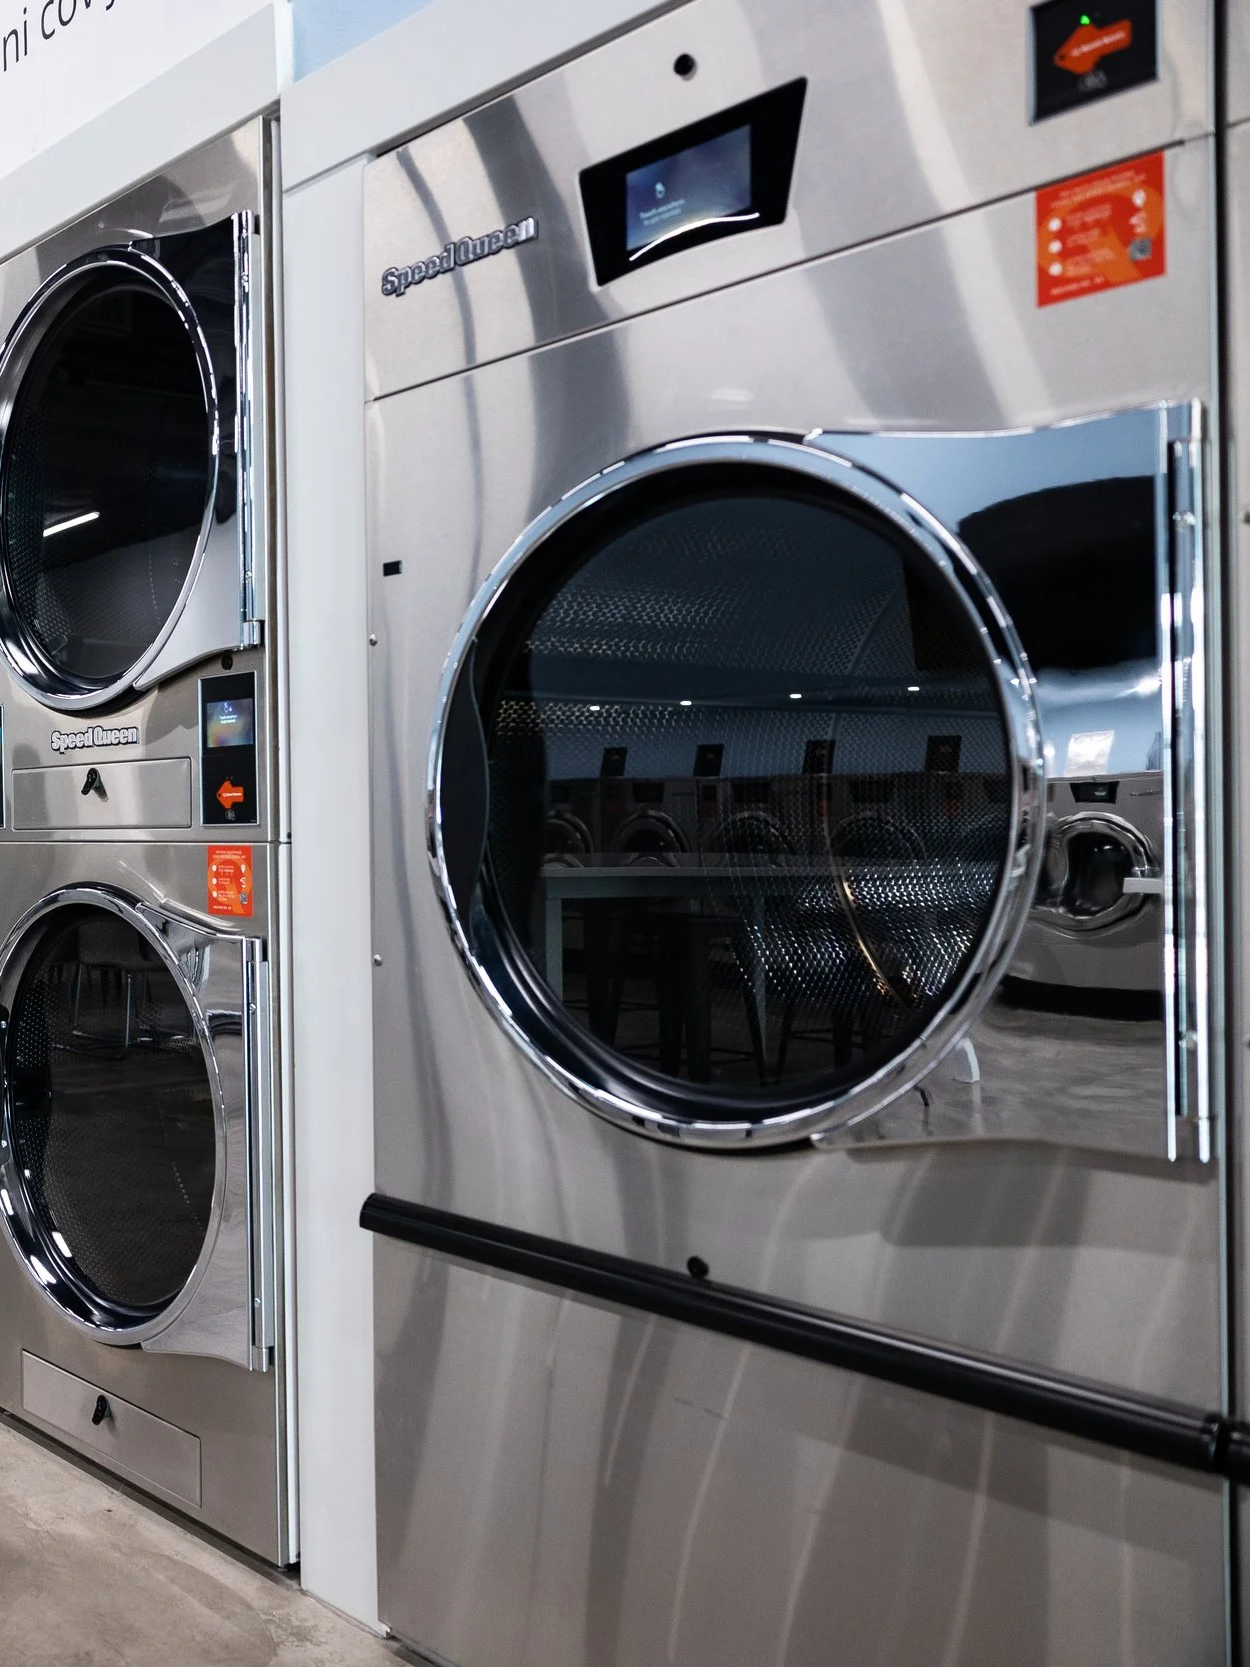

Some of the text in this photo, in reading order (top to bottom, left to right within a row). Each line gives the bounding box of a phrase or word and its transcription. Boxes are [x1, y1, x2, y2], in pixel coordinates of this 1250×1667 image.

[3, 6, 28, 72] ni
[381, 215, 539, 298] Speed Queen
[51, 725, 139, 755] Speed Queen
